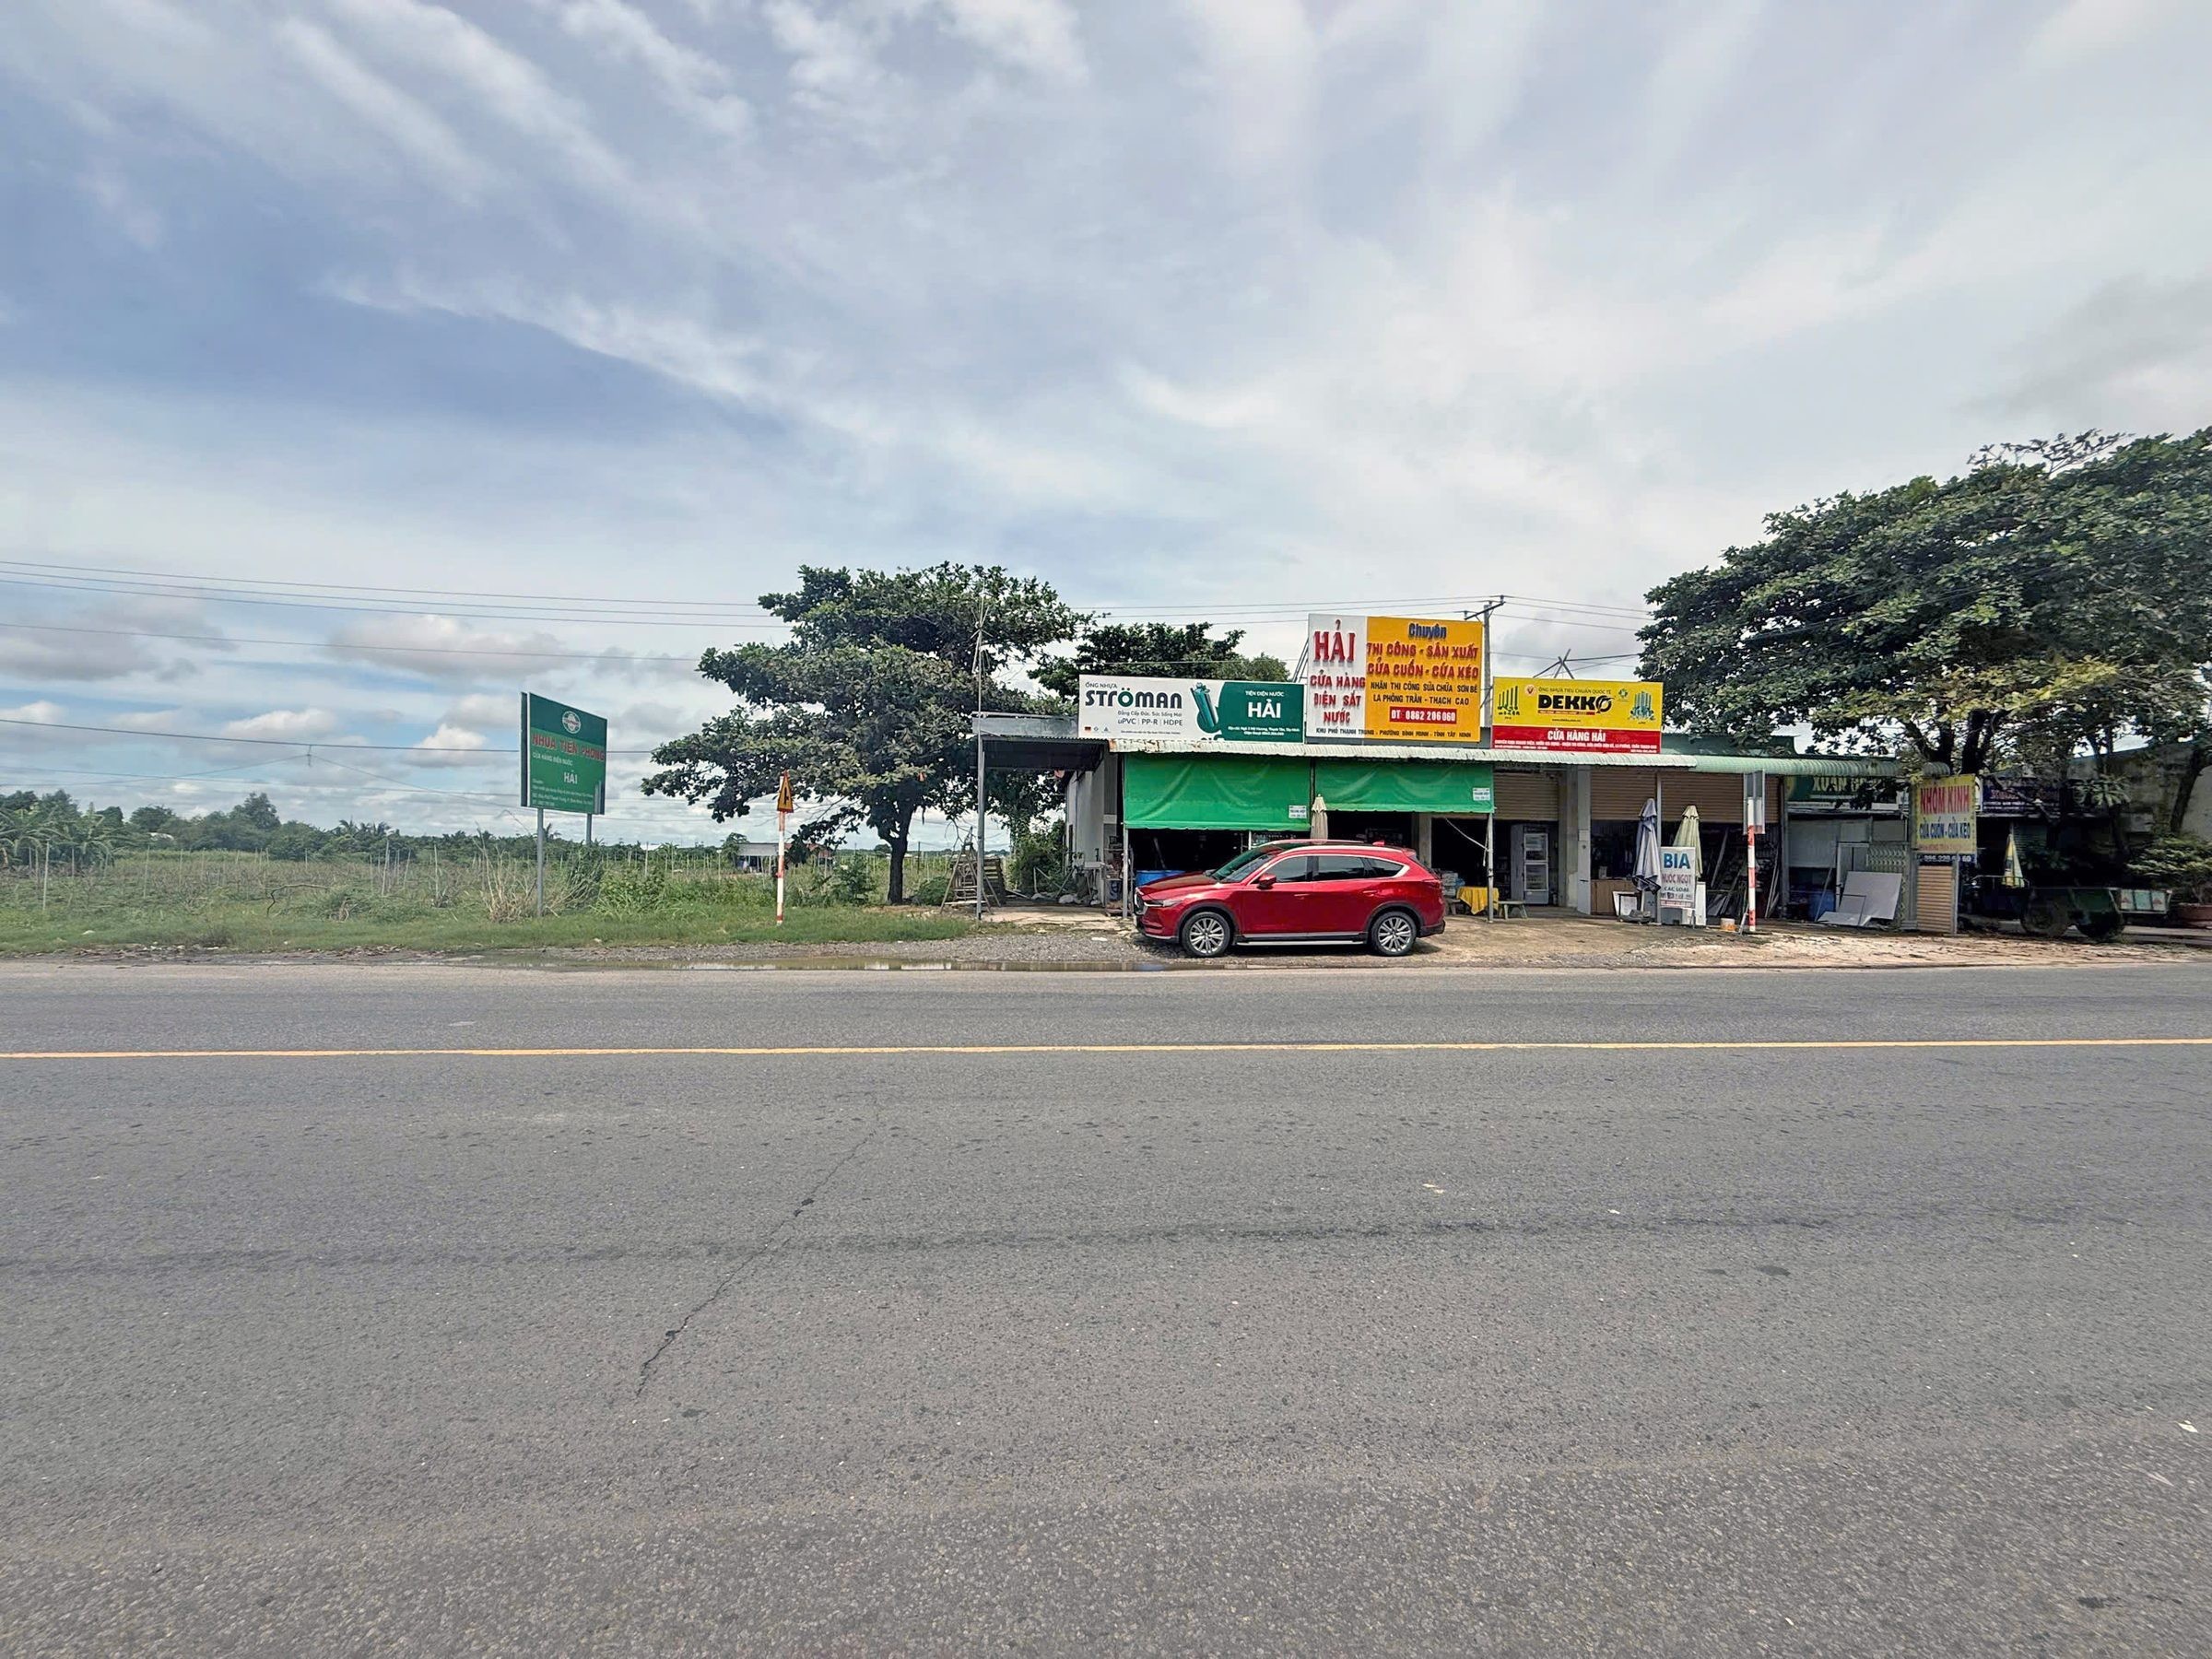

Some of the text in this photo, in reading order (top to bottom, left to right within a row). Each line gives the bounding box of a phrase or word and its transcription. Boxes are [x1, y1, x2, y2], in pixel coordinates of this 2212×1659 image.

[1313, 619, 1356, 663] HẢI
[1367, 642, 1382, 655] THI
[1386, 641, 1417, 657] CÔNG
[1452, 642, 1479, 659] XUẤT
[1367, 657, 1390, 675] CỬA
[1393, 659, 1423, 677] CUỐN
[1457, 663, 1479, 678] KÉO
[1310, 669, 1366, 688] CỬA HÀNG
[1391, 682, 1401, 690] THI
[1403, 681, 1420, 691] CÔNG
[1373, 694, 1381, 702] LA
[1430, 697, 1452, 706] THẠCH
[1455, 698, 1469, 706] CAO
[1538, 694, 1614, 713] DEKKO
[1248, 699, 1281, 719] HẢI
[1324, 708, 1350, 724] NƯỚC
[1405, 710, 1425, 721] 0862
[1547, 728, 1565, 741] CỬA
[1567, 729, 1590, 741] HÀNG
[1664, 853, 1691, 869] BIA
